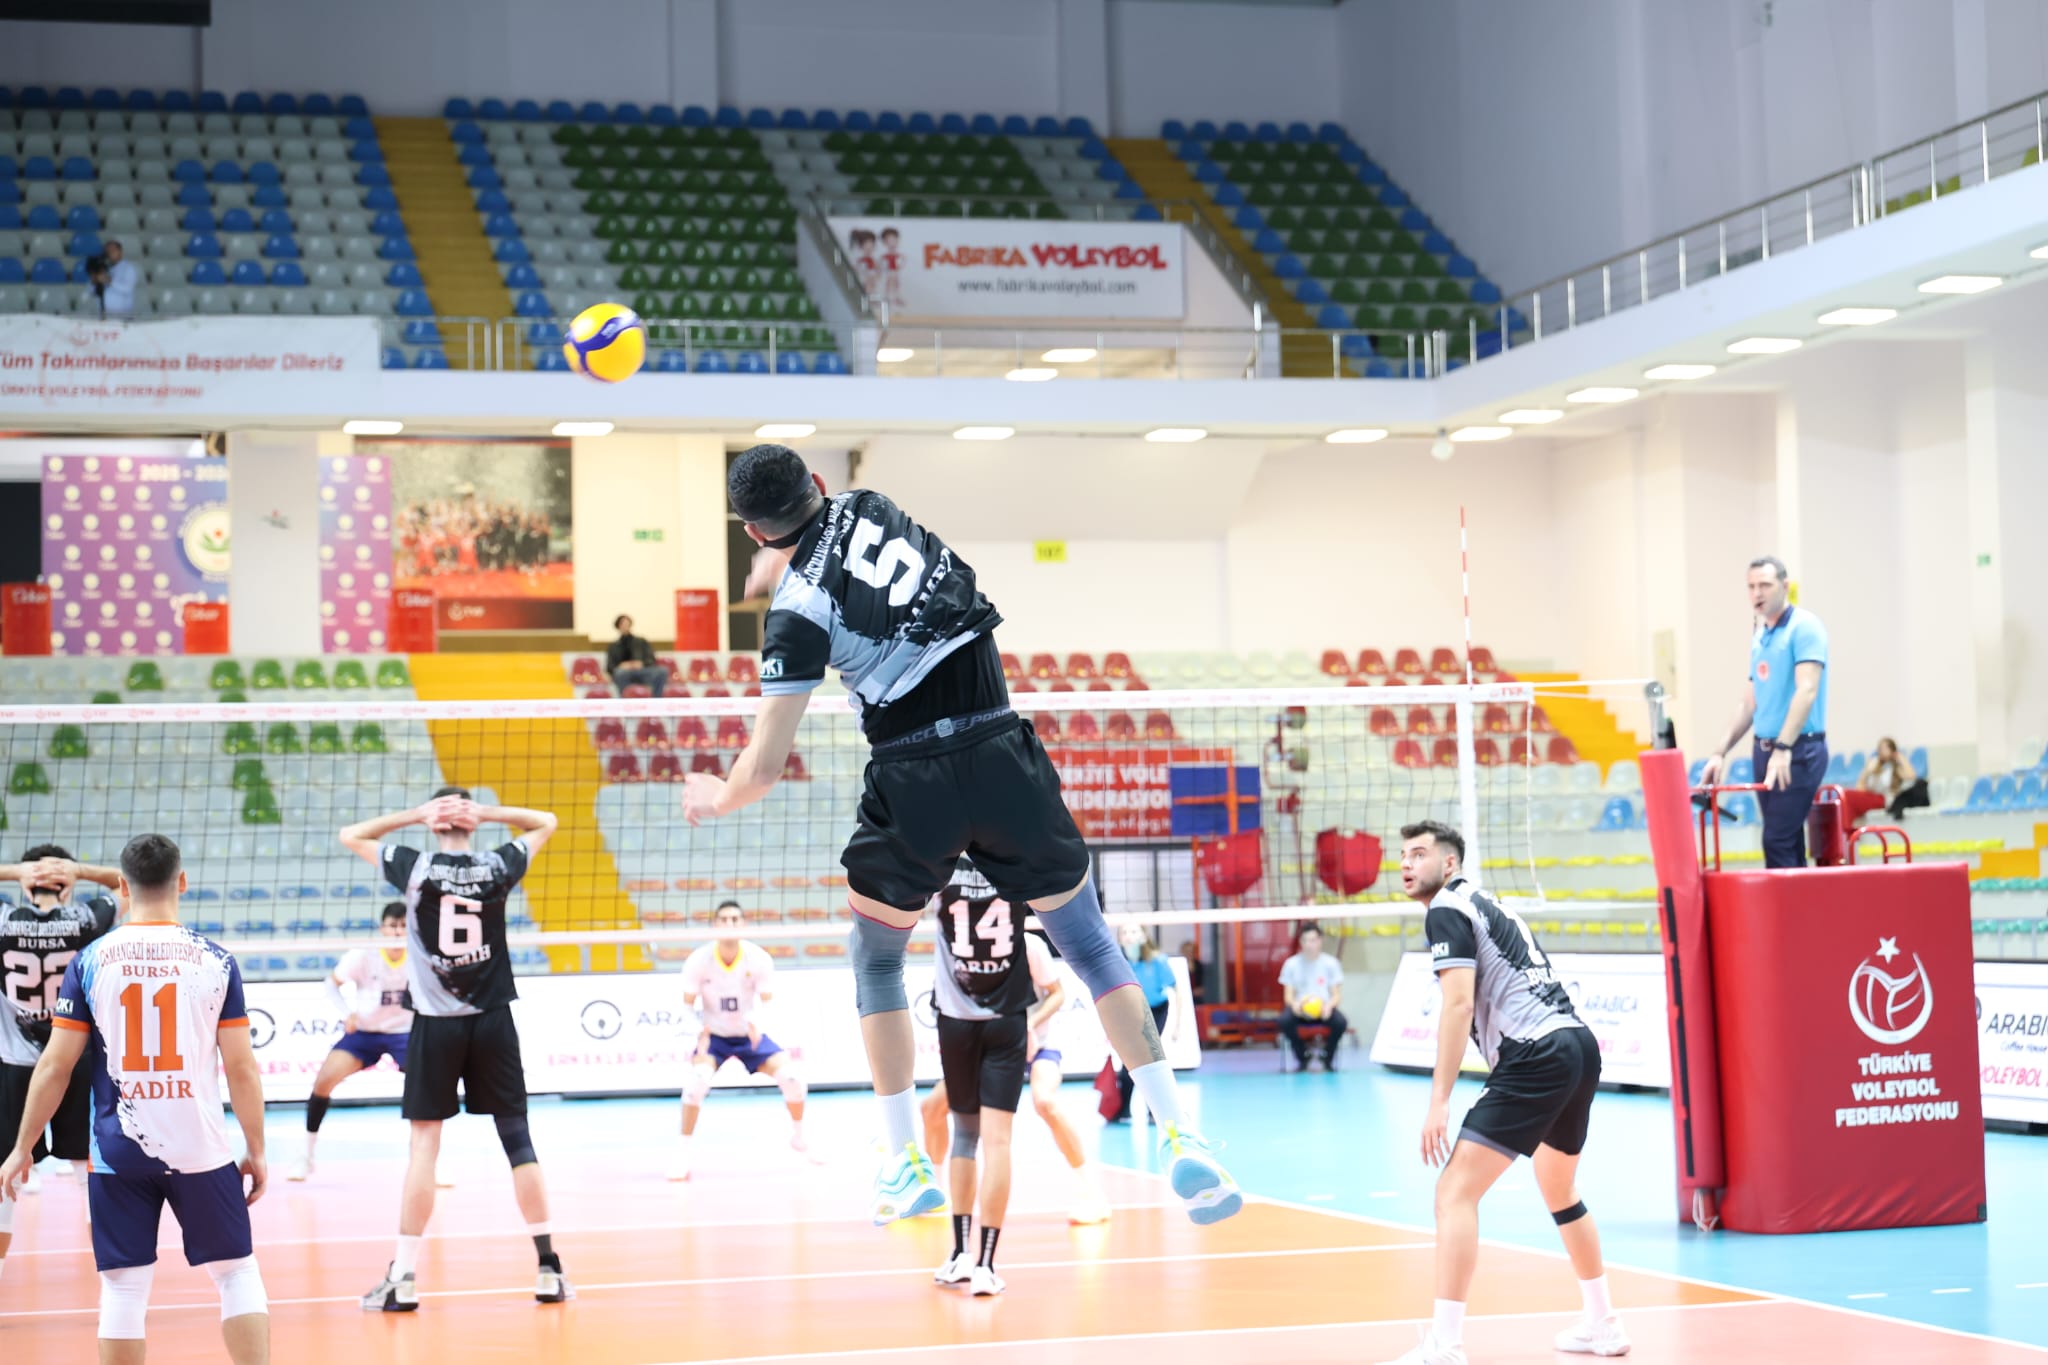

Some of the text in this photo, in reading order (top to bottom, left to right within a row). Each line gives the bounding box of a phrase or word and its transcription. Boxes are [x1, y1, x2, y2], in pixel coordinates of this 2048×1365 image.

[1031, 244, 1168, 271] VOLEYBOL
[842, 517, 927, 607] 5
[438, 894, 483, 957] 6
[948, 898, 1015, 958] 14
[18, 937, 67, 949] BURSA
[3, 950, 78, 1011] 22
[121, 963, 182, 978] BURSA
[119, 982, 185, 1072] 11
[1985, 1012, 2048, 1036] ARABI
[1858, 1050, 1932, 1076] TÜRKİYE
[120, 1074, 196, 1100] KADİR
[1851, 1077, 1941, 1101] VOLEYBOL
[1835, 1101, 1959, 1128] FEDERASYONU
